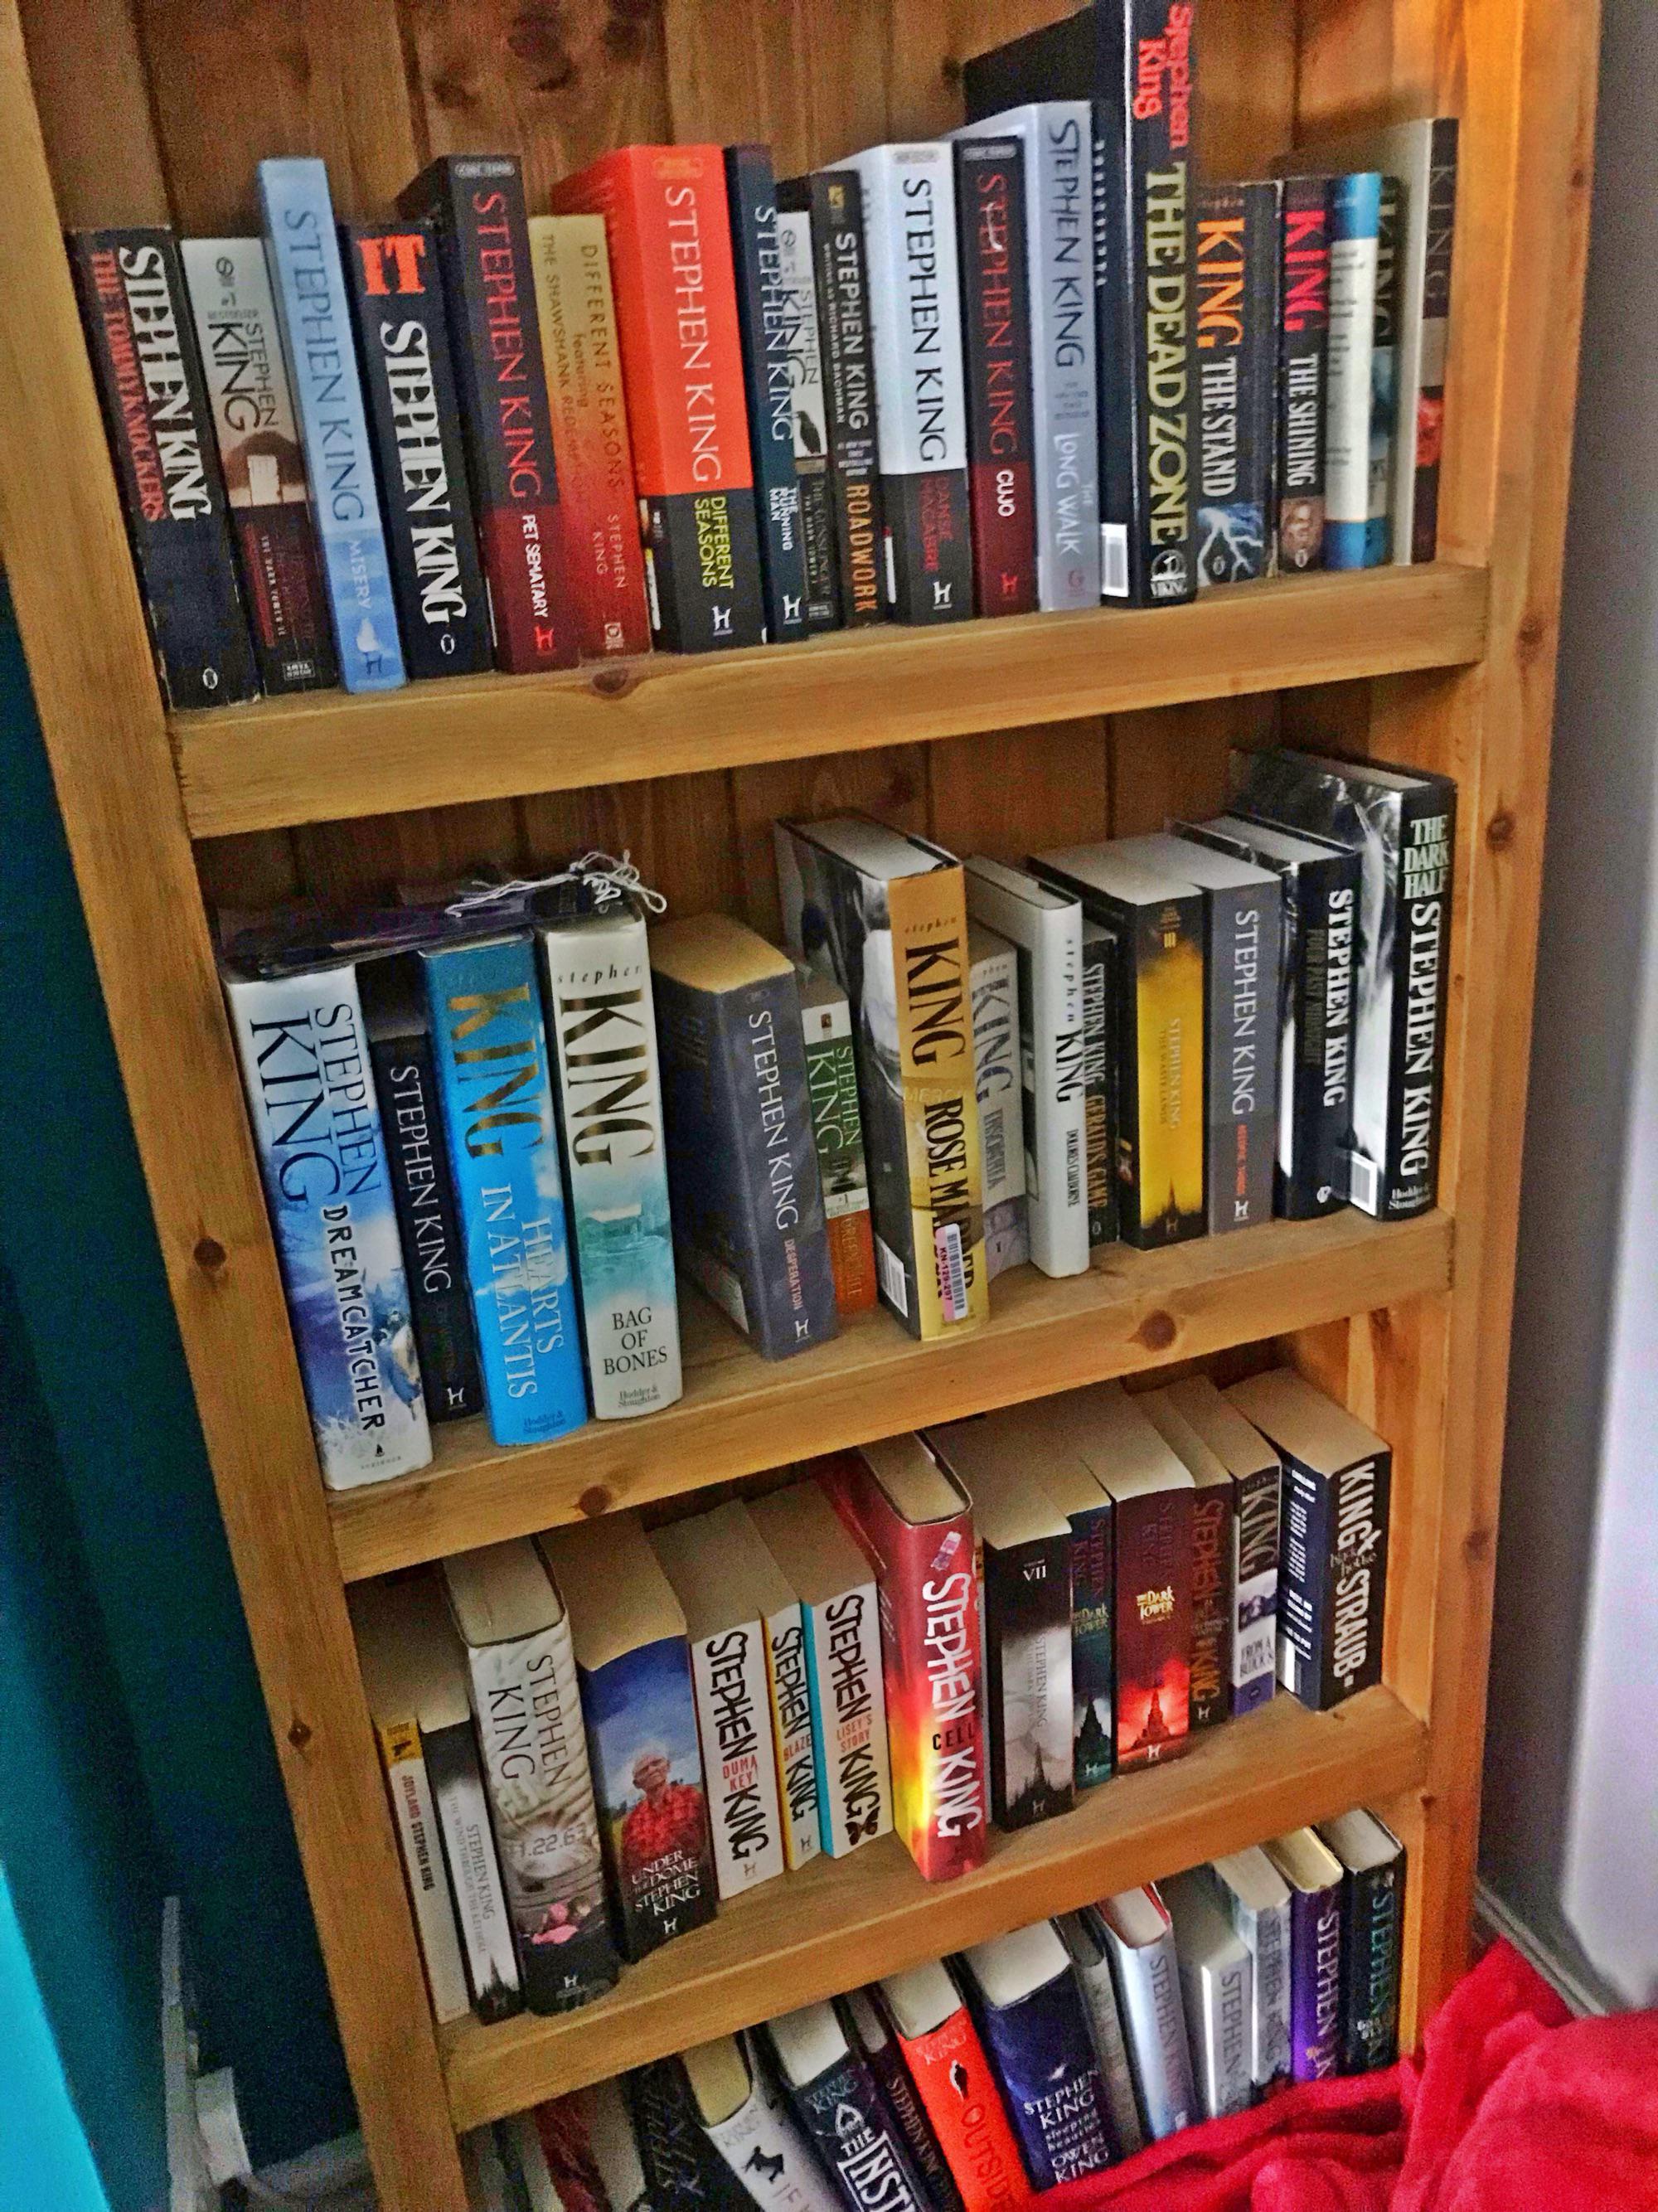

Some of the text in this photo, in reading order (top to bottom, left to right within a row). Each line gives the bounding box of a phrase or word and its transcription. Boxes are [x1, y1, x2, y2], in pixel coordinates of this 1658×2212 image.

[1132, 39, 1167, 119] King
[1164, 2, 1194, 149] Stephen
[1048, 119, 1084, 264] STEPHEN
[1146, 161, 1187, 265] THE
[357, 234, 426, 295] IT
[473, 192, 528, 381] STEPHEN
[541, 234, 562, 265] THE
[666, 187, 711, 370] STEPHEN
[835, 232, 864, 354] STEPHEN
[903, 178, 941, 354] STEPHEN
[977, 173, 1012, 348] STEPHEN
[1196, 218, 1245, 348] KING
[546, 274, 573, 388] SHAWSHANK
[581, 245, 626, 488] DIFFERENT SEASONS
[754, 205, 797, 441] STEPHEN KING
[1052, 275, 1086, 368] KING
[1147, 274, 1188, 409] DEAD
[1284, 210, 1328, 487] KING THE SHINING
[92, 251, 166, 521] THE TOMMYKNOCKERS
[120, 247, 212, 521] STEPHEN KING
[209, 323, 262, 432] KING
[245, 323, 279, 427] STEPHEN
[284, 210, 373, 610] STEPHEN KING MISERY
[846, 364, 870, 430] KING
[916, 367, 947, 462] KING
[987, 360, 1018, 454] KING
[1200, 357, 1238, 412] THE
[380, 321, 467, 625] STEPHEN KING
[500, 395, 541, 498] KING
[685, 382, 722, 482] KING
[1054, 432, 1083, 489] LONG
[1148, 414, 1190, 546] ZONE
[1200, 414, 1238, 497] STAND
[521, 514, 540, 541] PET
[694, 498, 718, 588] SEASONS
[710, 497, 734, 589] DIFFERENT
[769, 488, 783, 521] MAN
[996, 469, 1016, 517] CUJO
[1055, 493, 1084, 556] WALK
[526, 544, 549, 617] SEMATARY
[594, 531, 609, 575] KING
[606, 514, 628, 589] STEPHEN
[846, 483, 878, 613] ROADWORK
[905, 937, 966, 1067] KING
[972, 975, 1014, 1104] KING
[1231, 910, 1260, 1115] STEPHEN KING
[1323, 889, 1354, 1107] STEPHEN KING
[1400, 900, 1441, 1177] STEPHEN KING
[250, 1011, 342, 1205] KING
[315, 1003, 381, 1196] STEPHEN
[449, 982, 545, 1159] KING
[560, 988, 656, 1167] KING
[807, 1050, 844, 1154] KING
[836, 1045, 862, 1146] STEPHEN
[1055, 1028, 1087, 1104] KING
[390, 1065, 439, 1208] STEPHEN
[749, 1010, 804, 1310] STEPHEN KING DESPERATION
[924, 1095, 968, 1178] ROSE
[414, 1215, 452, 1293] KING
[481, 1183, 538, 1399] IN ATLANTIS
[521, 1217, 564, 1353] HEARTS
[323, 1205, 386, 1431] DREAMCATCHER
[604, 1346, 668, 1376] BONES
[612, 1307, 652, 1331] BAG
[621, 1329, 648, 1351] OF
[1239, 1482, 1280, 1582] KING
[1338, 1461, 1375, 1551] KING
[1022, 1565, 1046, 1582] VII
[1332, 1568, 1371, 1679] STRAUB
[706, 1630, 759, 1762] STEPHEN
[772, 1627, 812, 1739] STEPHEN
[826, 1594, 871, 1724] STEPHEN
[922, 1572, 977, 1723] STEPHEN
[1034, 1636, 1048, 1729] STEPHEN KING
[489, 1685, 536, 1780] KING
[527, 1654, 572, 1787] STEPHEN
[722, 1754, 758, 1784] DUMA
[783, 1733, 812, 1762] BLAZE
[841, 1728, 870, 1754] STORY
[933, 1722, 977, 1751] CELL
[724, 1783, 769, 1861] KING
[730, 1773, 753, 1797] KEY
[785, 1754, 817, 1822] KING
[839, 1743, 880, 1822] KING
[933, 1746, 982, 1838] KING
[466, 1824, 496, 1920] STEPHEN KING
[653, 1884, 701, 1916] KING
[1221, 1970, 1246, 2078] STEPHEN
[1316, 1910, 1340, 2038] STEPHEN
[840, 2125, 877, 2157] THE
[1040, 2092, 1095, 2129] KING
